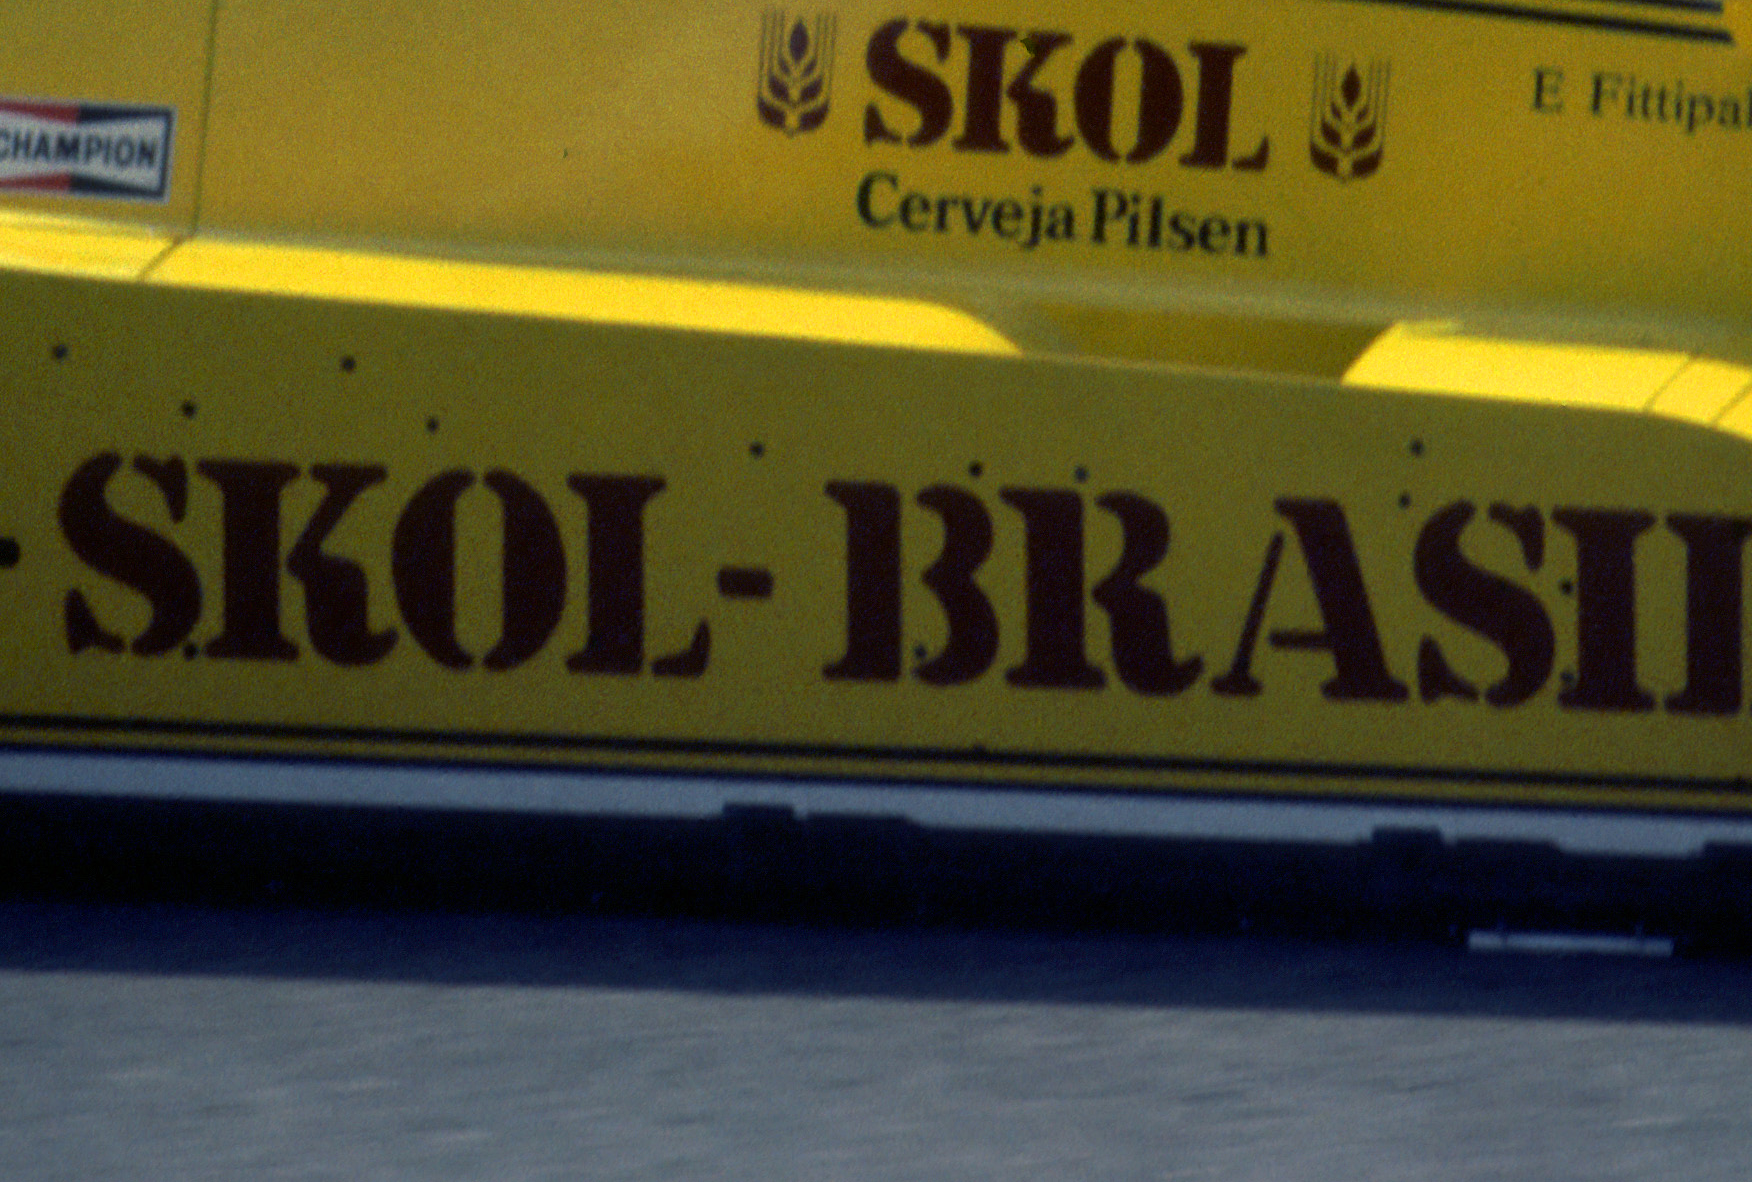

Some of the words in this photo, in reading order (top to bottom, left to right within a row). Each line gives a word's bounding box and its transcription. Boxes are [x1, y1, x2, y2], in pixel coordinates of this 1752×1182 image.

[863, 17, 1270, 171] SKOL
[856, 170, 1076, 251] Cerveja
[1090, 186, 1269, 257] Pilsen
